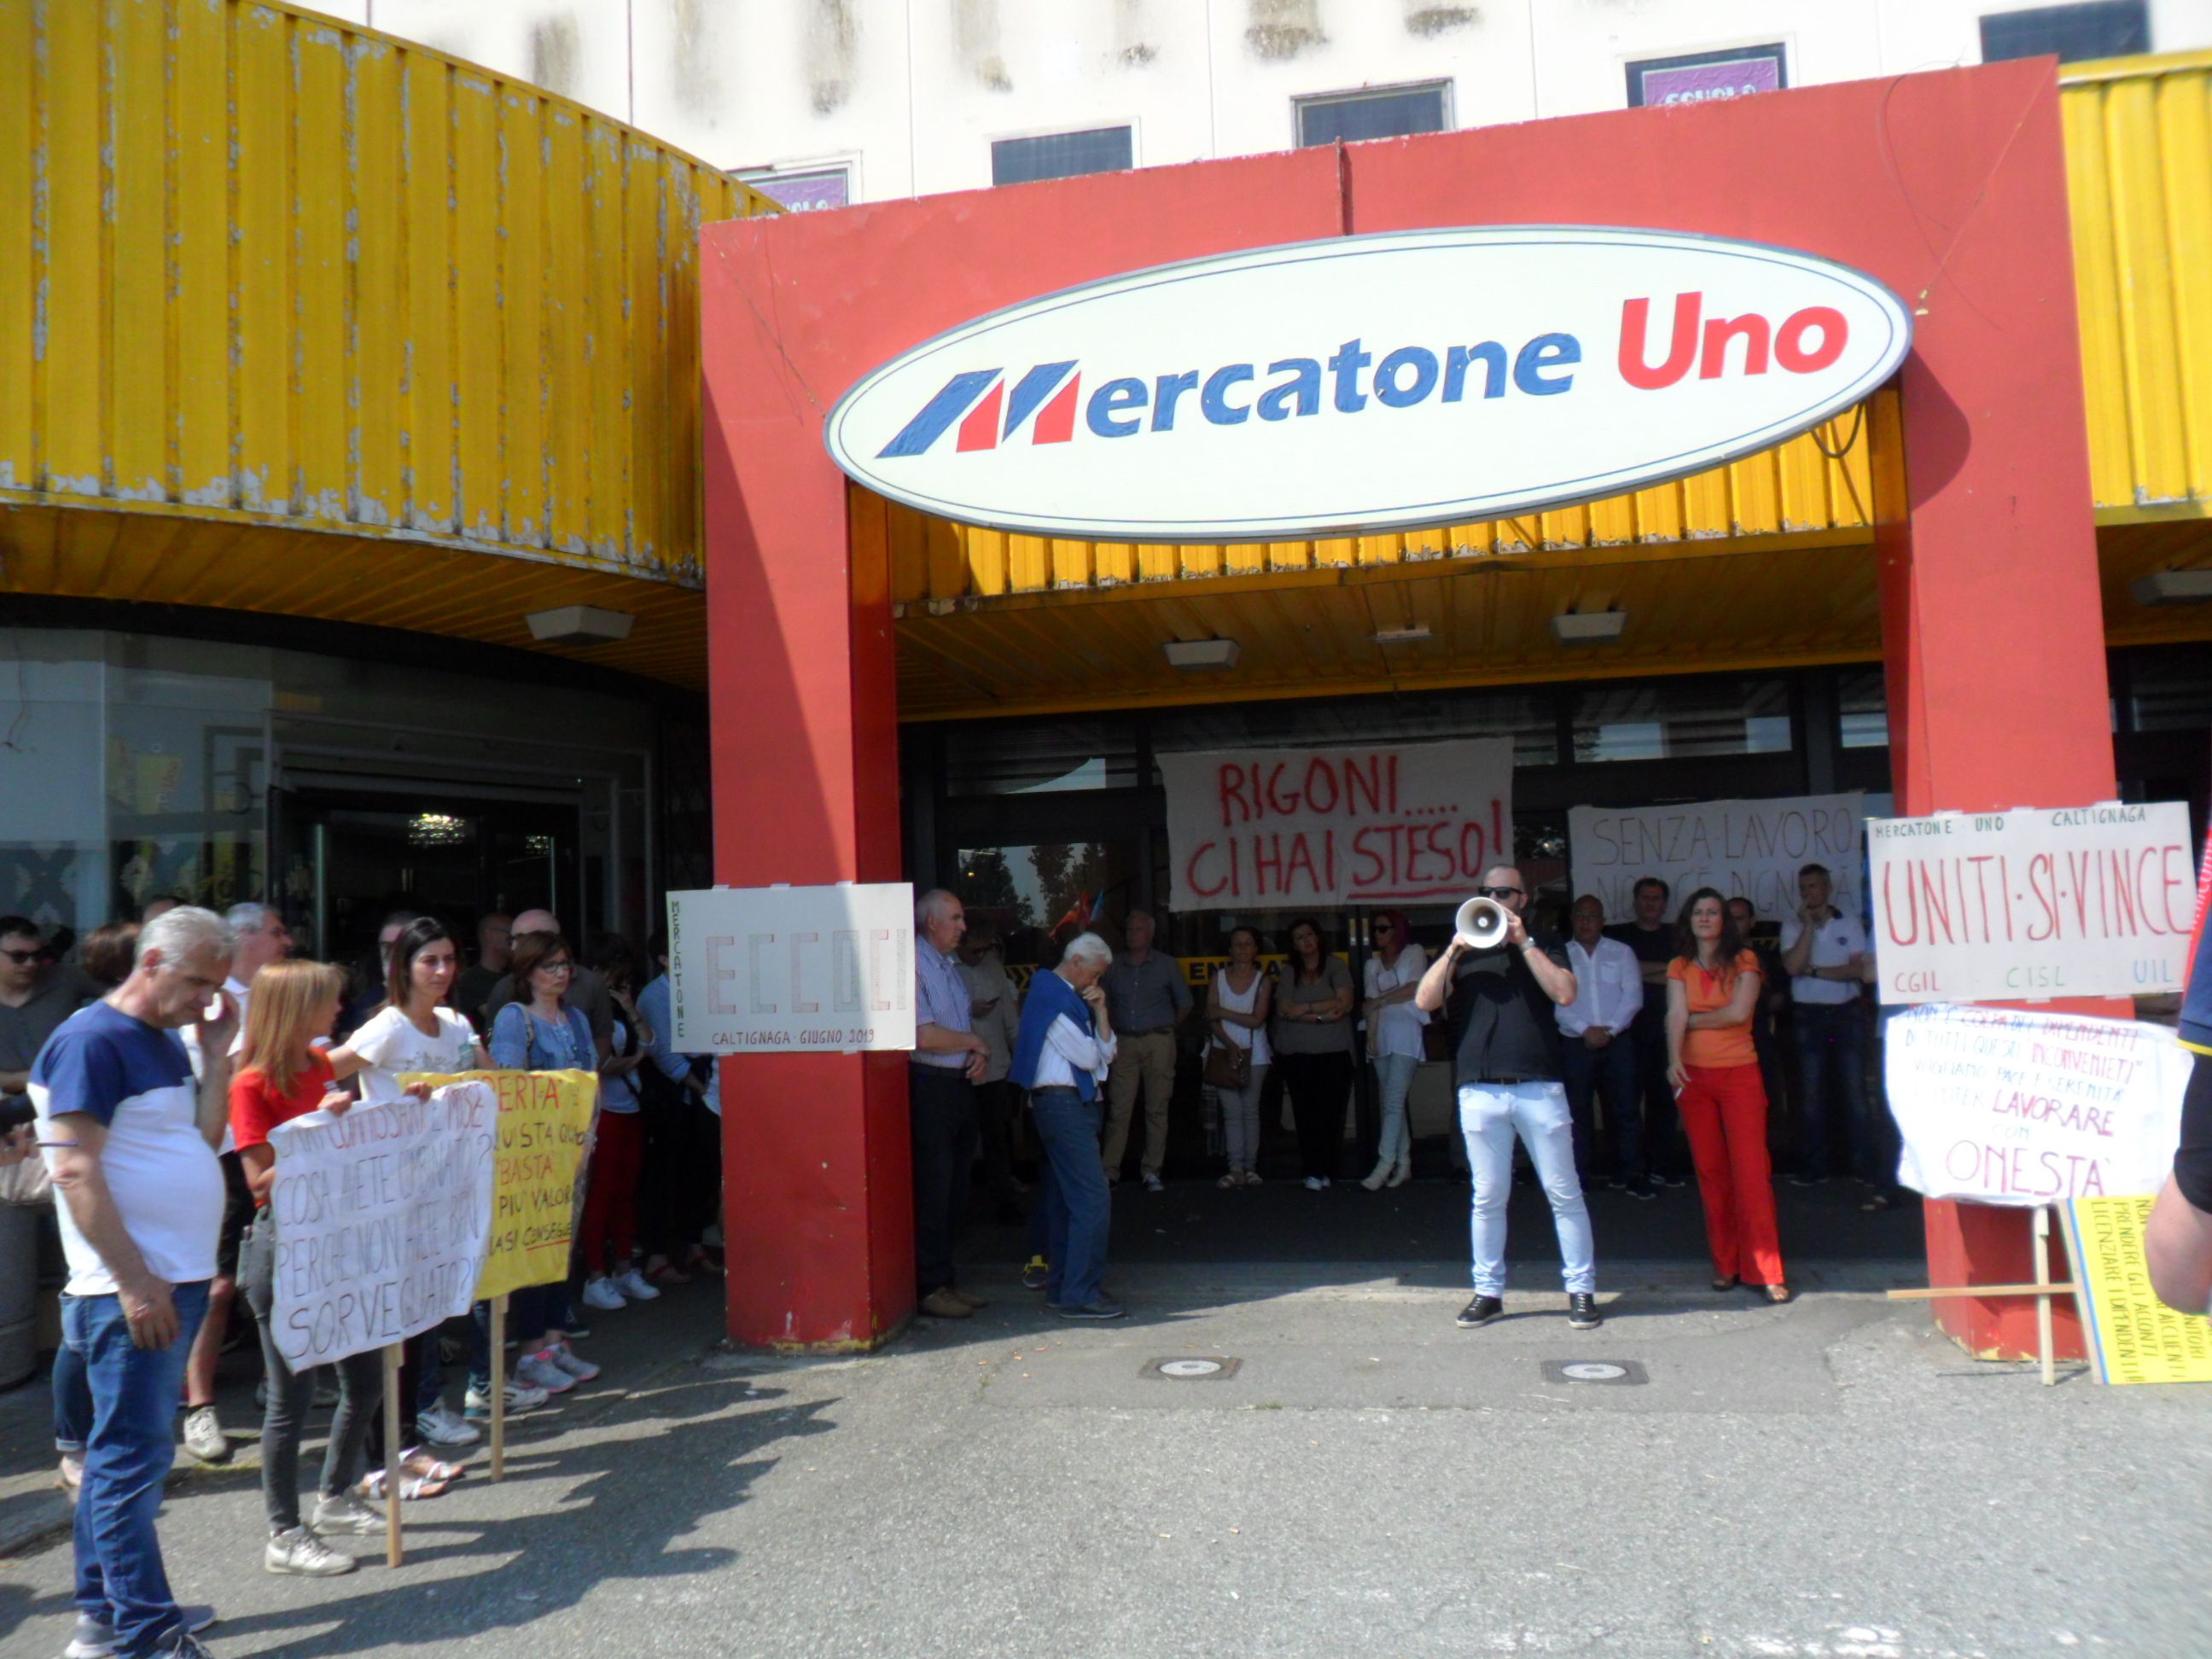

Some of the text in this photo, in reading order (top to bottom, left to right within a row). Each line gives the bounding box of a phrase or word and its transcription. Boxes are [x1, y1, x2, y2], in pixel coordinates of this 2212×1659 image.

[874, 291, 1848, 459] Mercatone Uno
[1186, 800, 1503, 897] CI HAI STESO!
[1592, 807, 1853, 865] SENZA LAVORO
[1876, 806, 2146, 839] MERCATONE UNO CALTIGNAGA
[2068, 845, 2192, 940] VINCE
[671, 900, 684, 1038] MERCATONE
[1895, 959, 2174, 992] CGIL CISL UIL
[712, 1028, 875, 1046] CALTIGNAGA GIUGNO 2019
[1927, 1029, 1967, 1052] TUTTI
[1973, 1035, 2021, 1059] QUESTI
[1963, 1010, 2007, 1029] COLPA
[1914, 1058, 1988, 1079] VOGLIAMO
[1996, 1066, 2026, 1086] PACE
[1991, 1121, 2029, 1142] CON
[1992, 1089, 2115, 1138] LAVORARE
[275, 1168, 335, 1226] COSA
[531, 1183, 573, 1213] VALOR
[357, 1216, 401, 1276] NON
[2092, 1201, 2123, 1283] LICENZIARE
[2114, 1202, 2159, 1357] PRENDERE GLI ACCONTI
